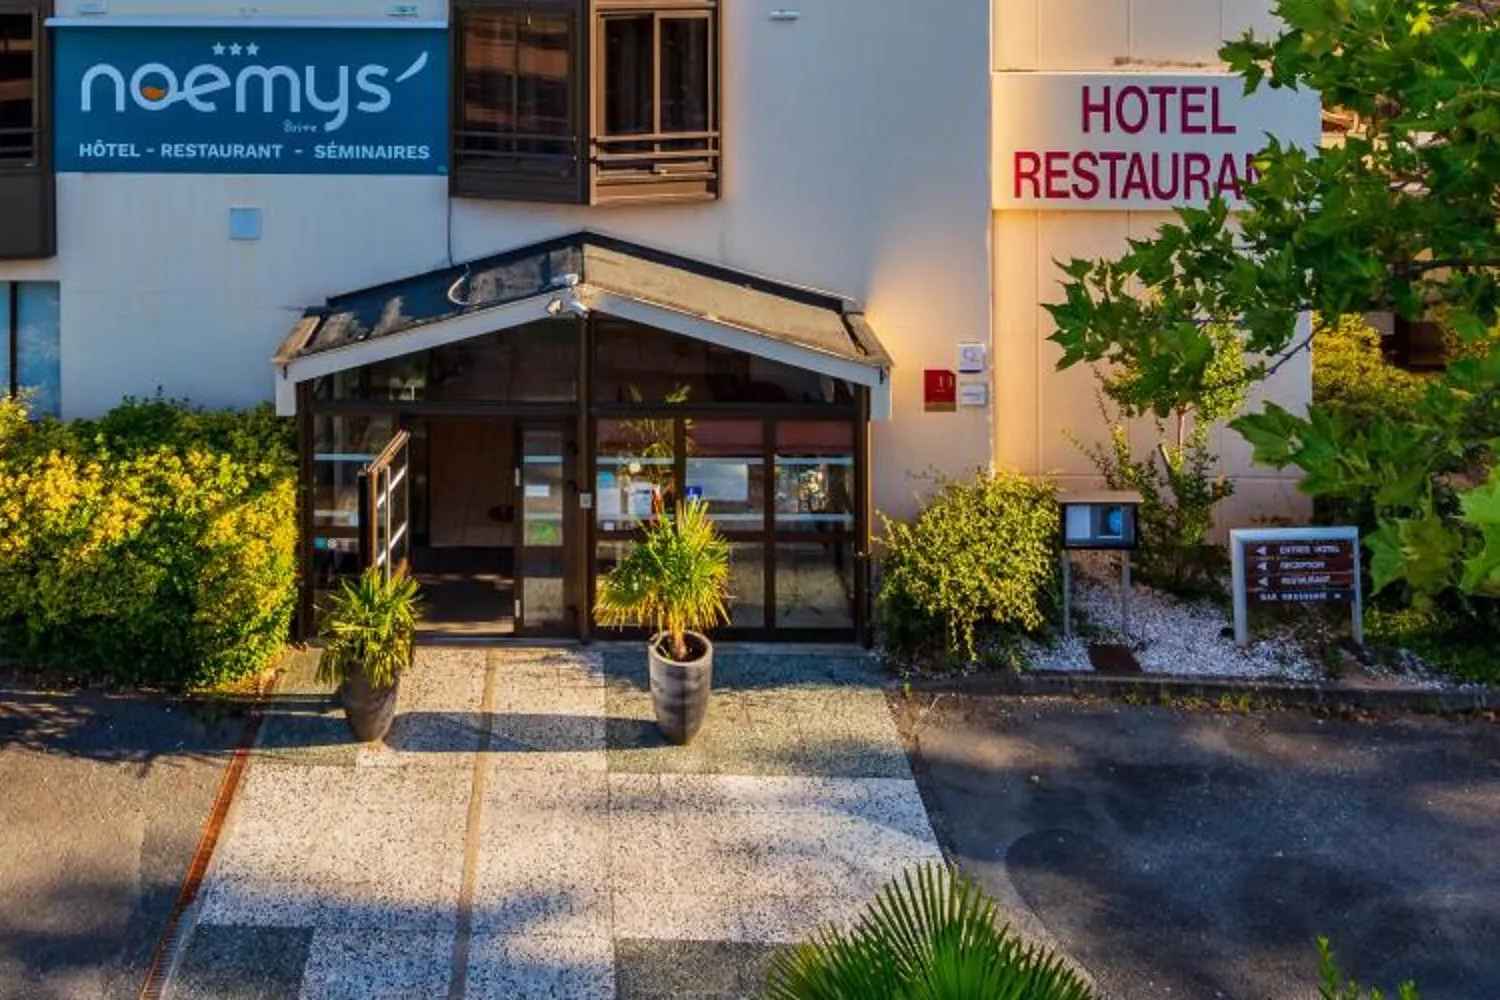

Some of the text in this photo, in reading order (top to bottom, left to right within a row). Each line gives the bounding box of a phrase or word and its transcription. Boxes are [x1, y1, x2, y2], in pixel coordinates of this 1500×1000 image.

[1081, 85, 1237, 134] HOTEL
[79, 139, 141, 158] HÔTEL
[161, 142, 283, 159] RESTAURANT
[314, 141, 430, 160] SÉMINAIRES
